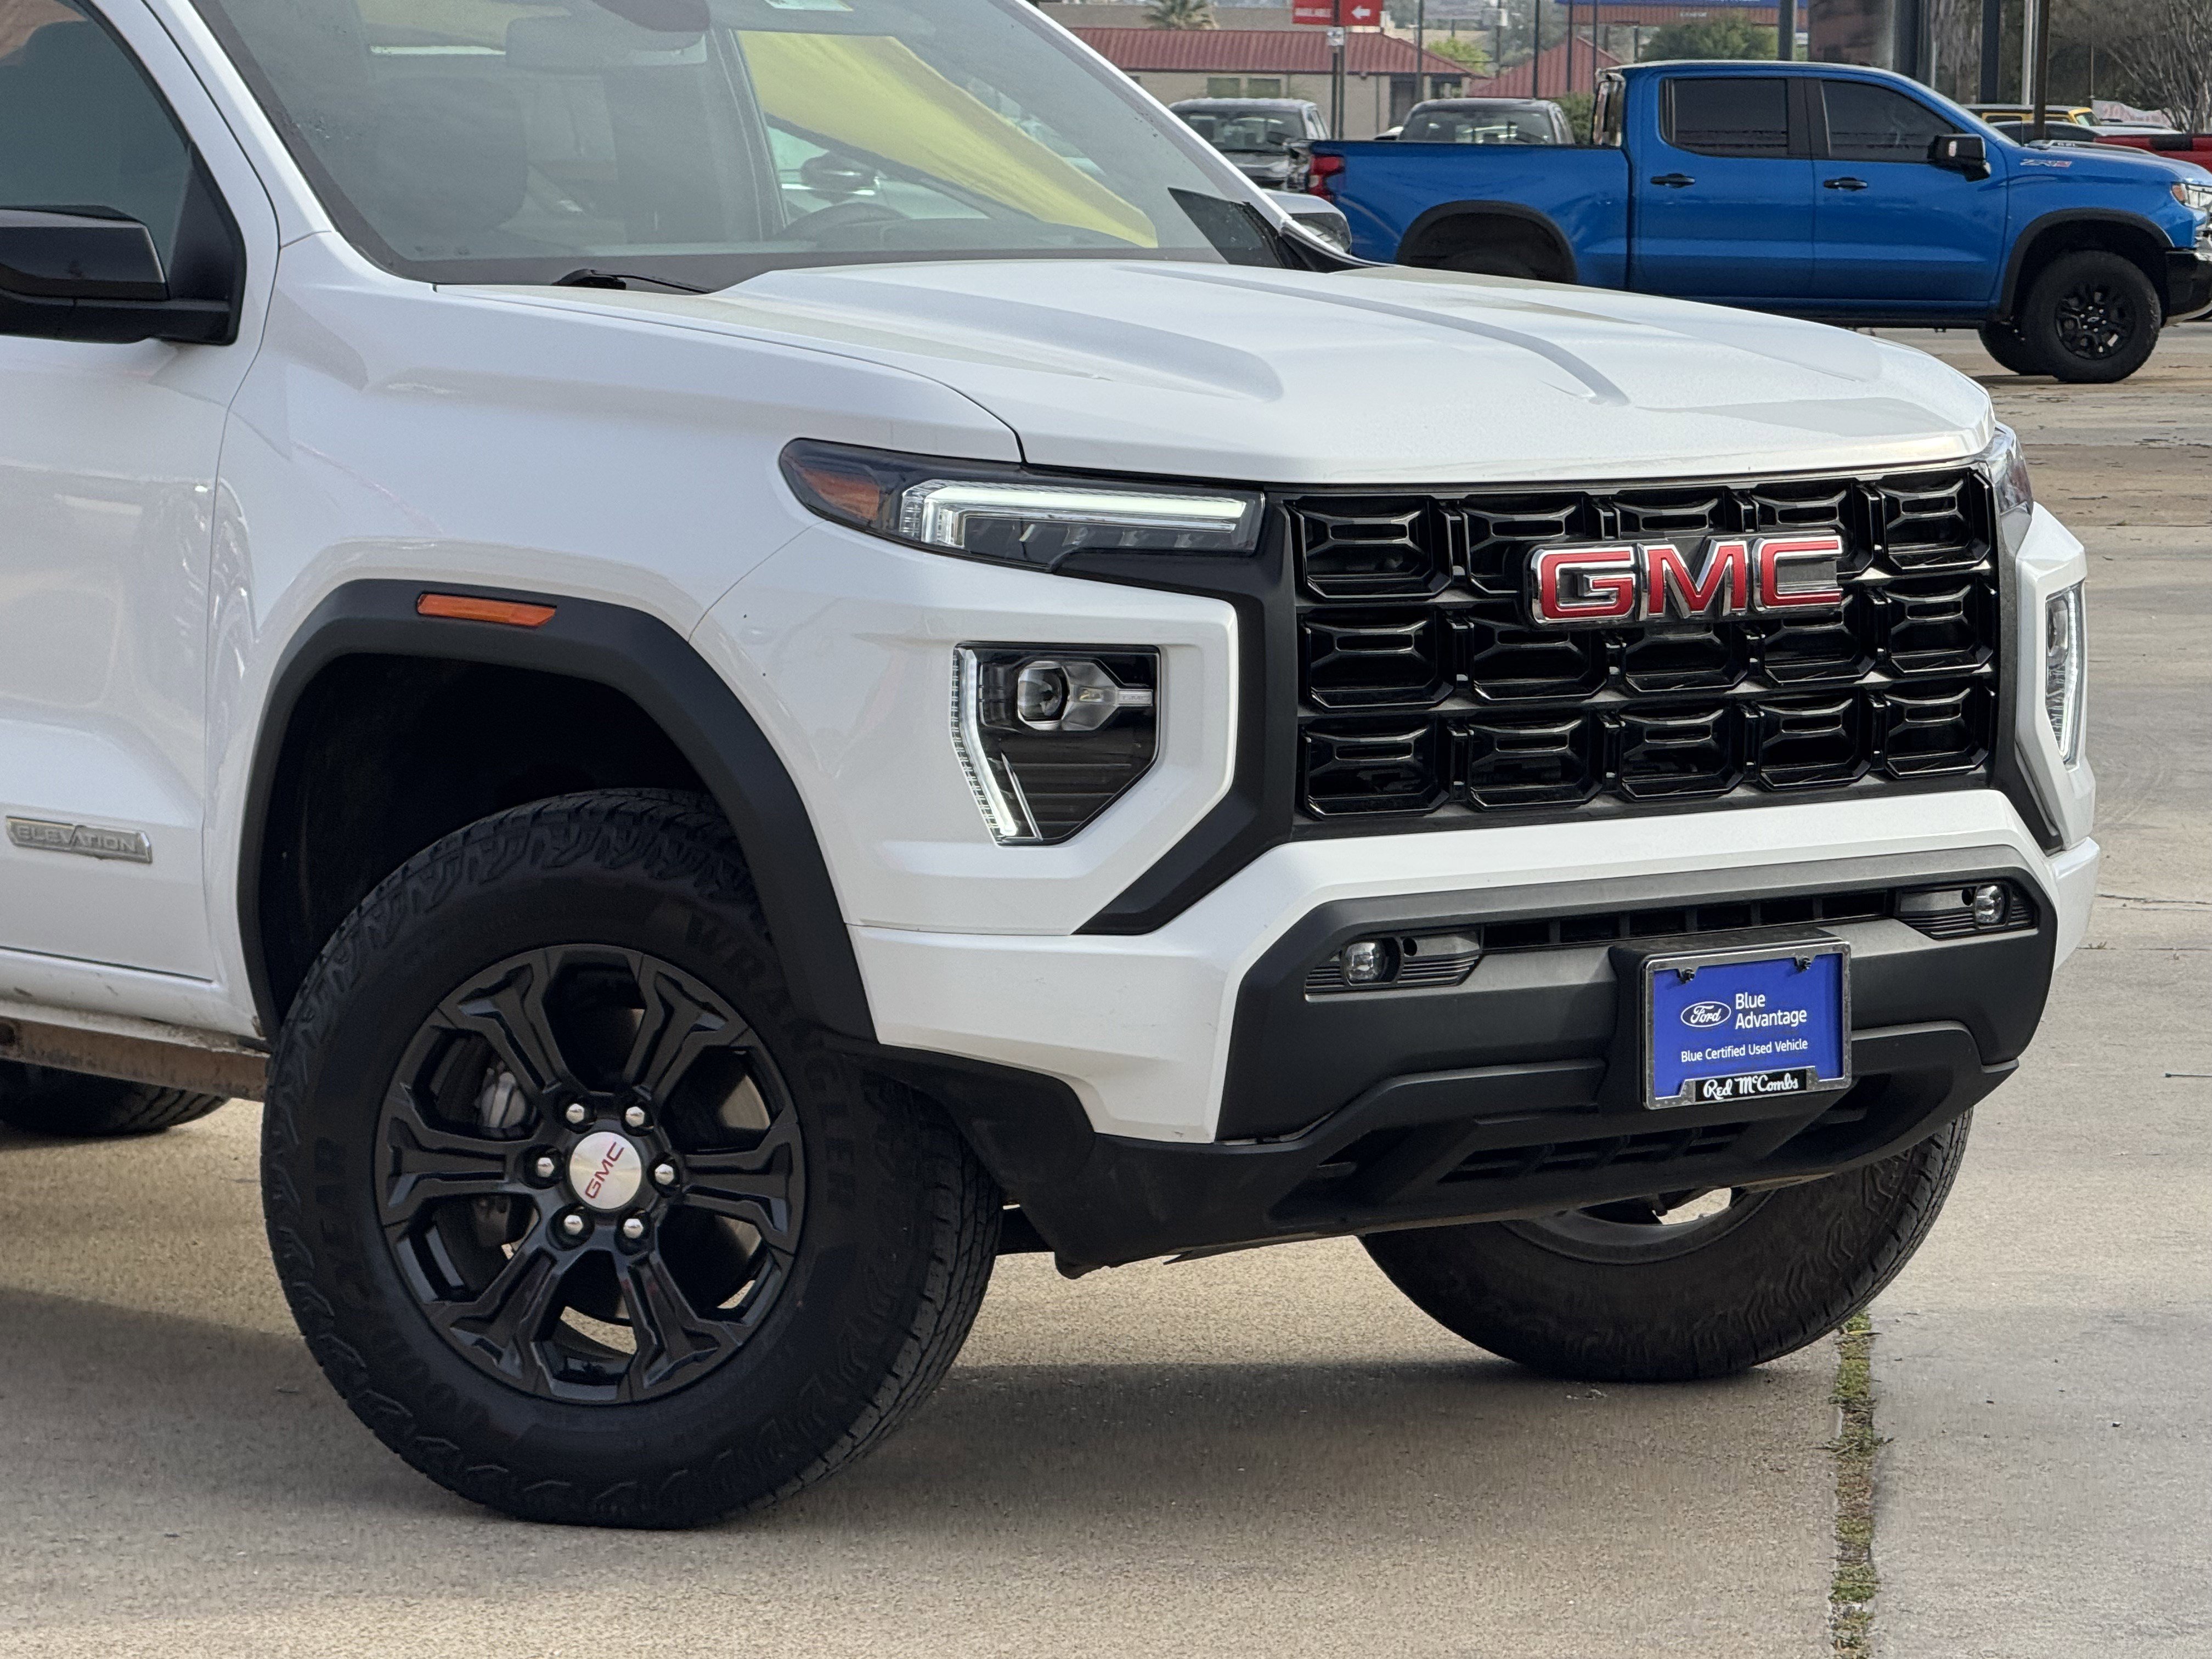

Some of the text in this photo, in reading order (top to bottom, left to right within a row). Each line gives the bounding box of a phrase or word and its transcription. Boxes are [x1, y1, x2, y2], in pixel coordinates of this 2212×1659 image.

[1531, 536, 1843, 623] GMC
[1735, 992, 1766, 1010] Blue
[1690, 1005, 1722, 1024] Ford
[1735, 1009, 1807, 1030] Advantage
[1681, 1038, 1808, 1063] Blue Certified Used Vehicle
[1703, 1073, 1799, 1101] Red McCombs
[585, 1142, 624, 1199] GMC
